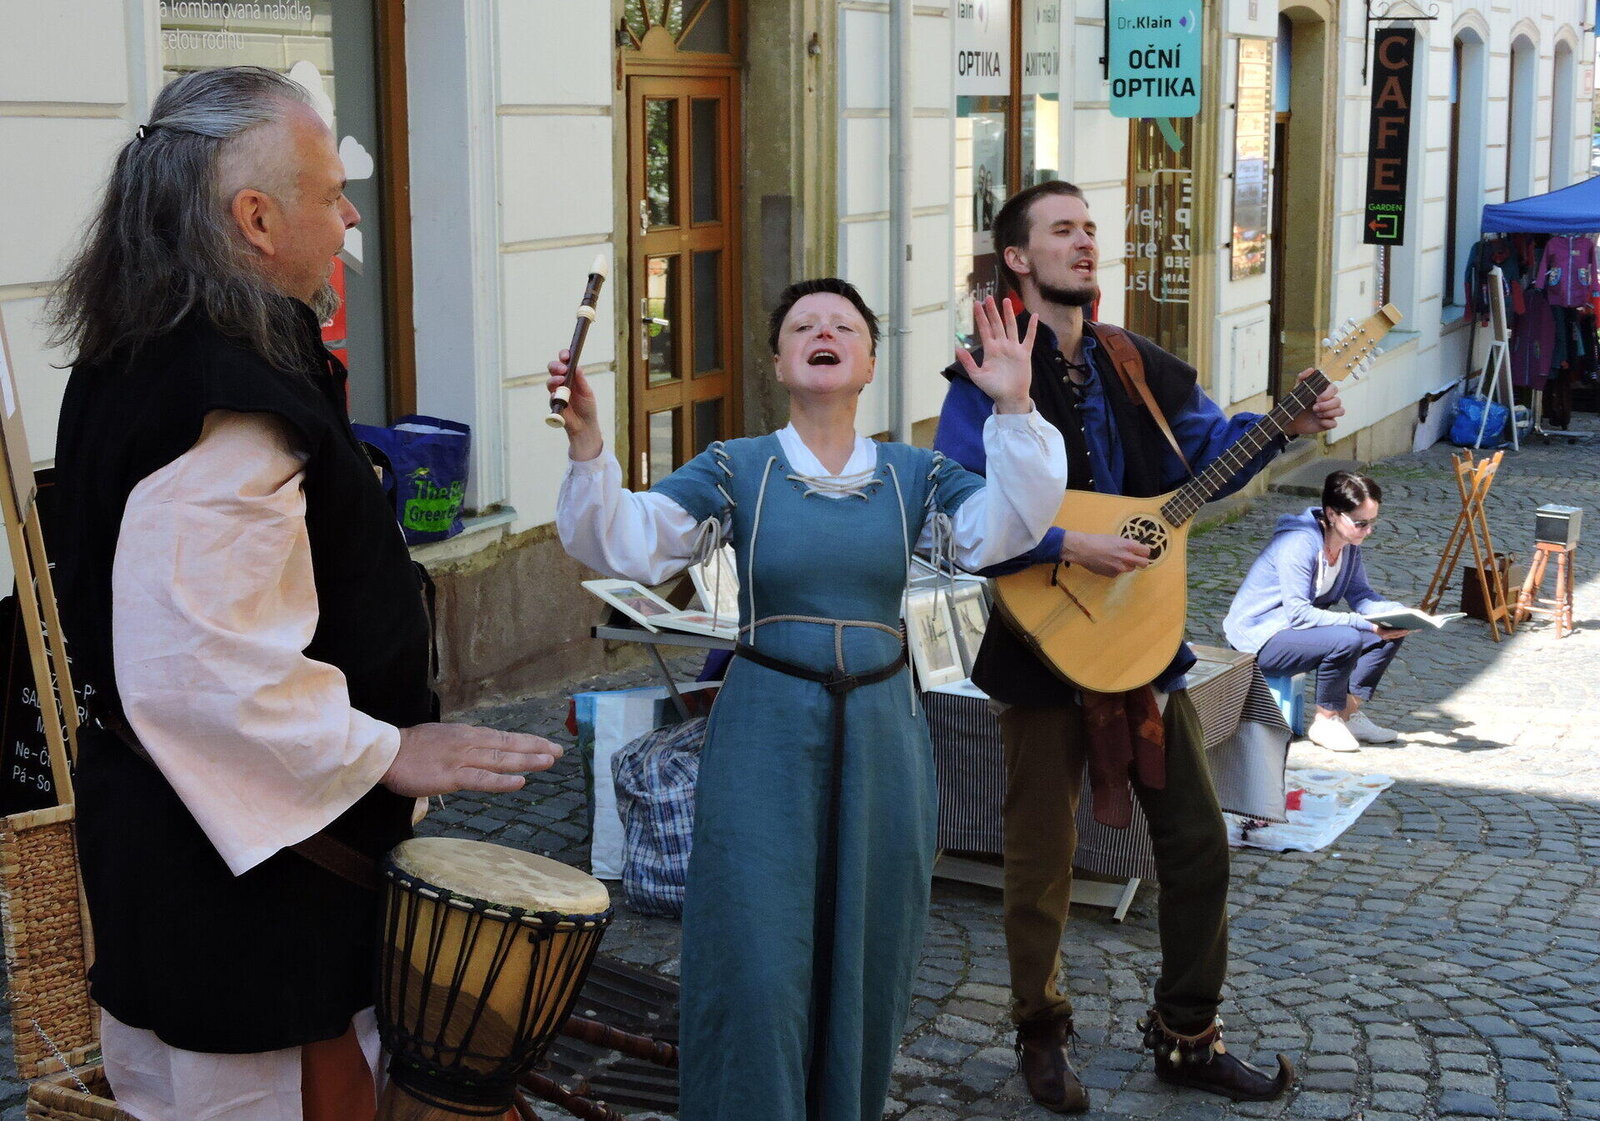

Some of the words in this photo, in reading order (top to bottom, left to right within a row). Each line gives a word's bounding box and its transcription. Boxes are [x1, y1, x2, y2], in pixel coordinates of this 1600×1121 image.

[172, 0, 261, 20] kombinovaná
[265, 0, 312, 21] nabídka
[1118, 16, 1172, 30] Dr.Klain
[958, 50, 1001, 77] OPTIKA
[1129, 43, 1182, 69] OČNÍ
[1112, 77, 1196, 98] OPTIKA
[1374, 36, 1409, 191] CAFE
[1369, 203, 1403, 211] GARDEN
